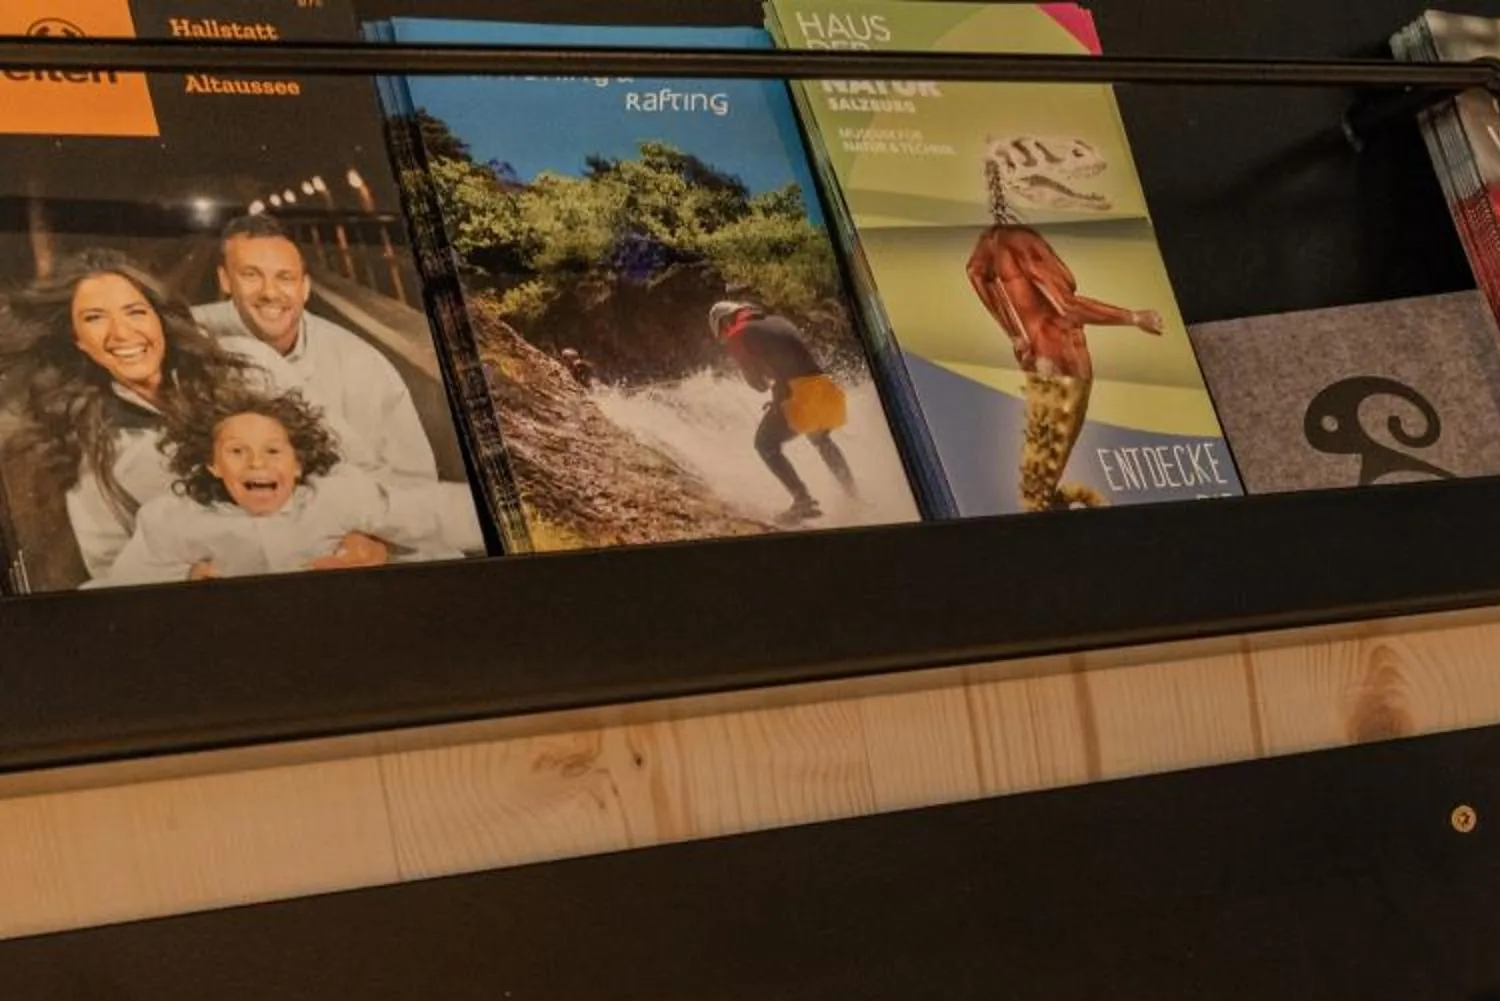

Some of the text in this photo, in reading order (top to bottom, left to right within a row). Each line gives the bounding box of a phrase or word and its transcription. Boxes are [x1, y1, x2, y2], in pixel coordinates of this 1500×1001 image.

[168, 17, 280, 42] Hallstatt
[796, 11, 892, 42] HAUS
[183, 73, 301, 96] Altaussee
[625, 89, 730, 116] Rafting
[828, 97, 916, 114] SALZBURG
[1097, 442, 1229, 492] ENTDECKE
